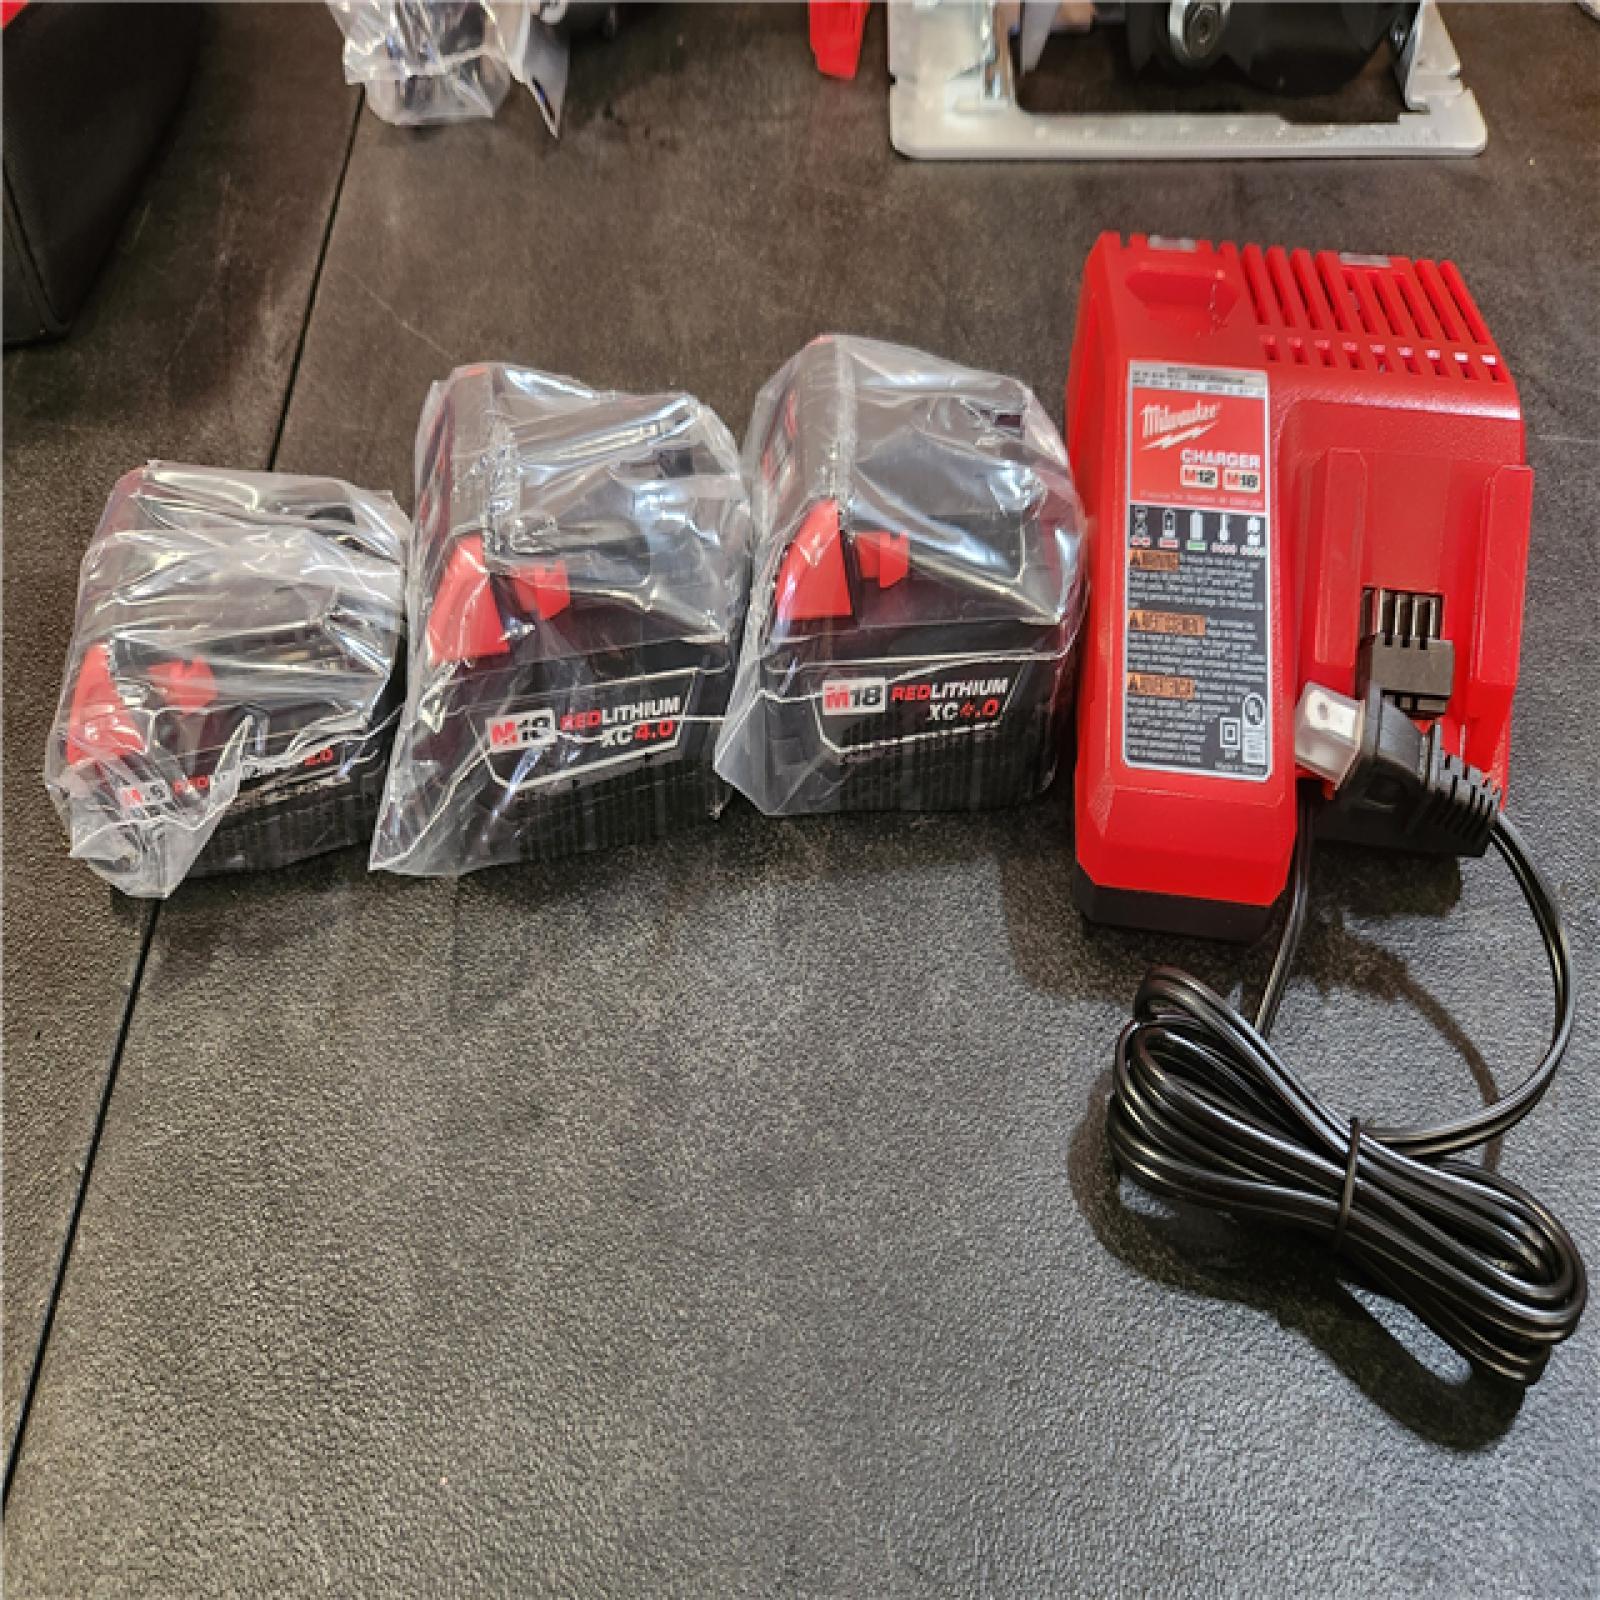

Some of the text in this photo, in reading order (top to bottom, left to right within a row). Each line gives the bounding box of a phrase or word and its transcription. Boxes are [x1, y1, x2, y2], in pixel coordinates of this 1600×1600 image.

[1181, 449, 1260, 468] CHARGER
[824, 677, 1009, 709] M18 REDLITHIUM
[560, 695, 681, 731] REDLITHIUM
